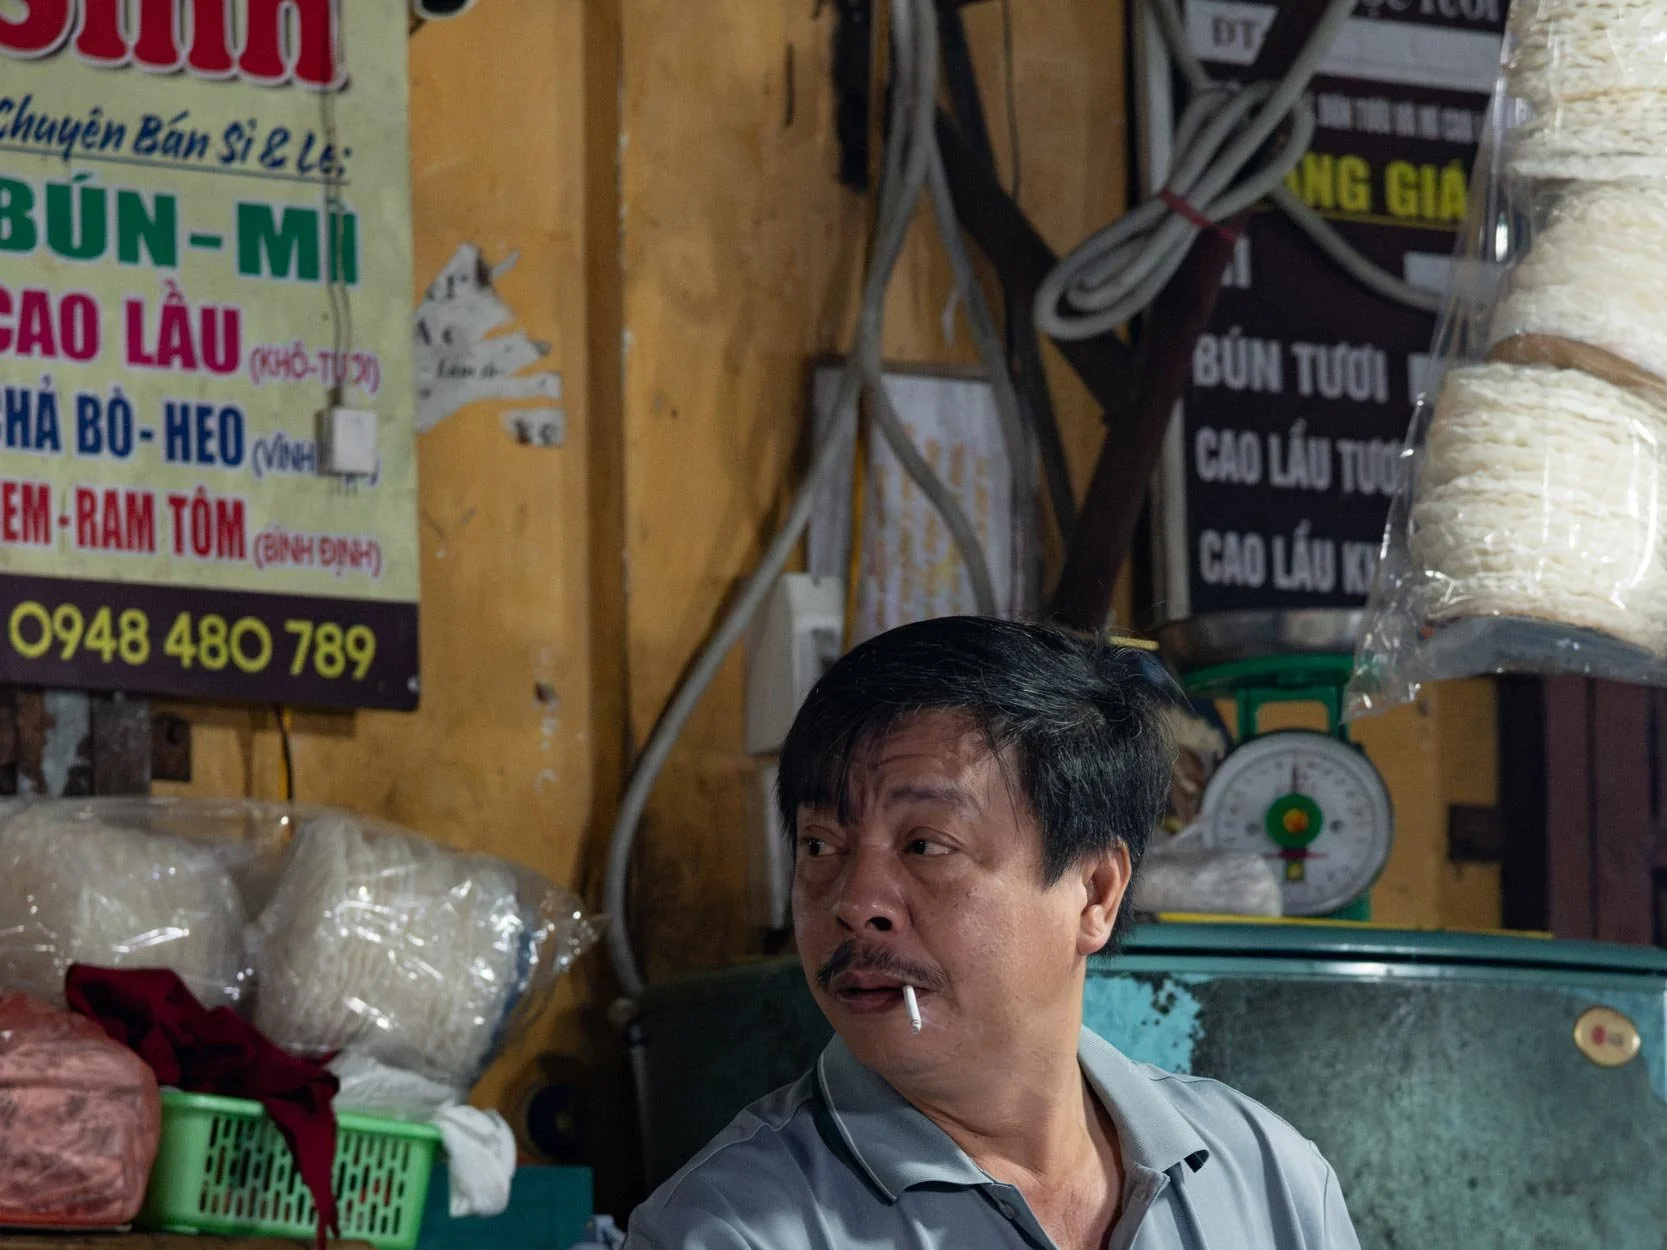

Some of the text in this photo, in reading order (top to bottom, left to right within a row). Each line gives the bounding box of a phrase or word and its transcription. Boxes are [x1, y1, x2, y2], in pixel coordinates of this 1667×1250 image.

[132, 110, 210, 160] Bán
[258, 125, 291, 169] &
[1193, 325, 1390, 404] BÚN TƯƠI
[0, 375, 60, 453] HẢ
[1195, 426, 1264, 486] CAO
[168, 485, 246, 561] TÔM
[1199, 529, 1267, 589] CAO
[9, 601, 376, 680] 0948 480 789
